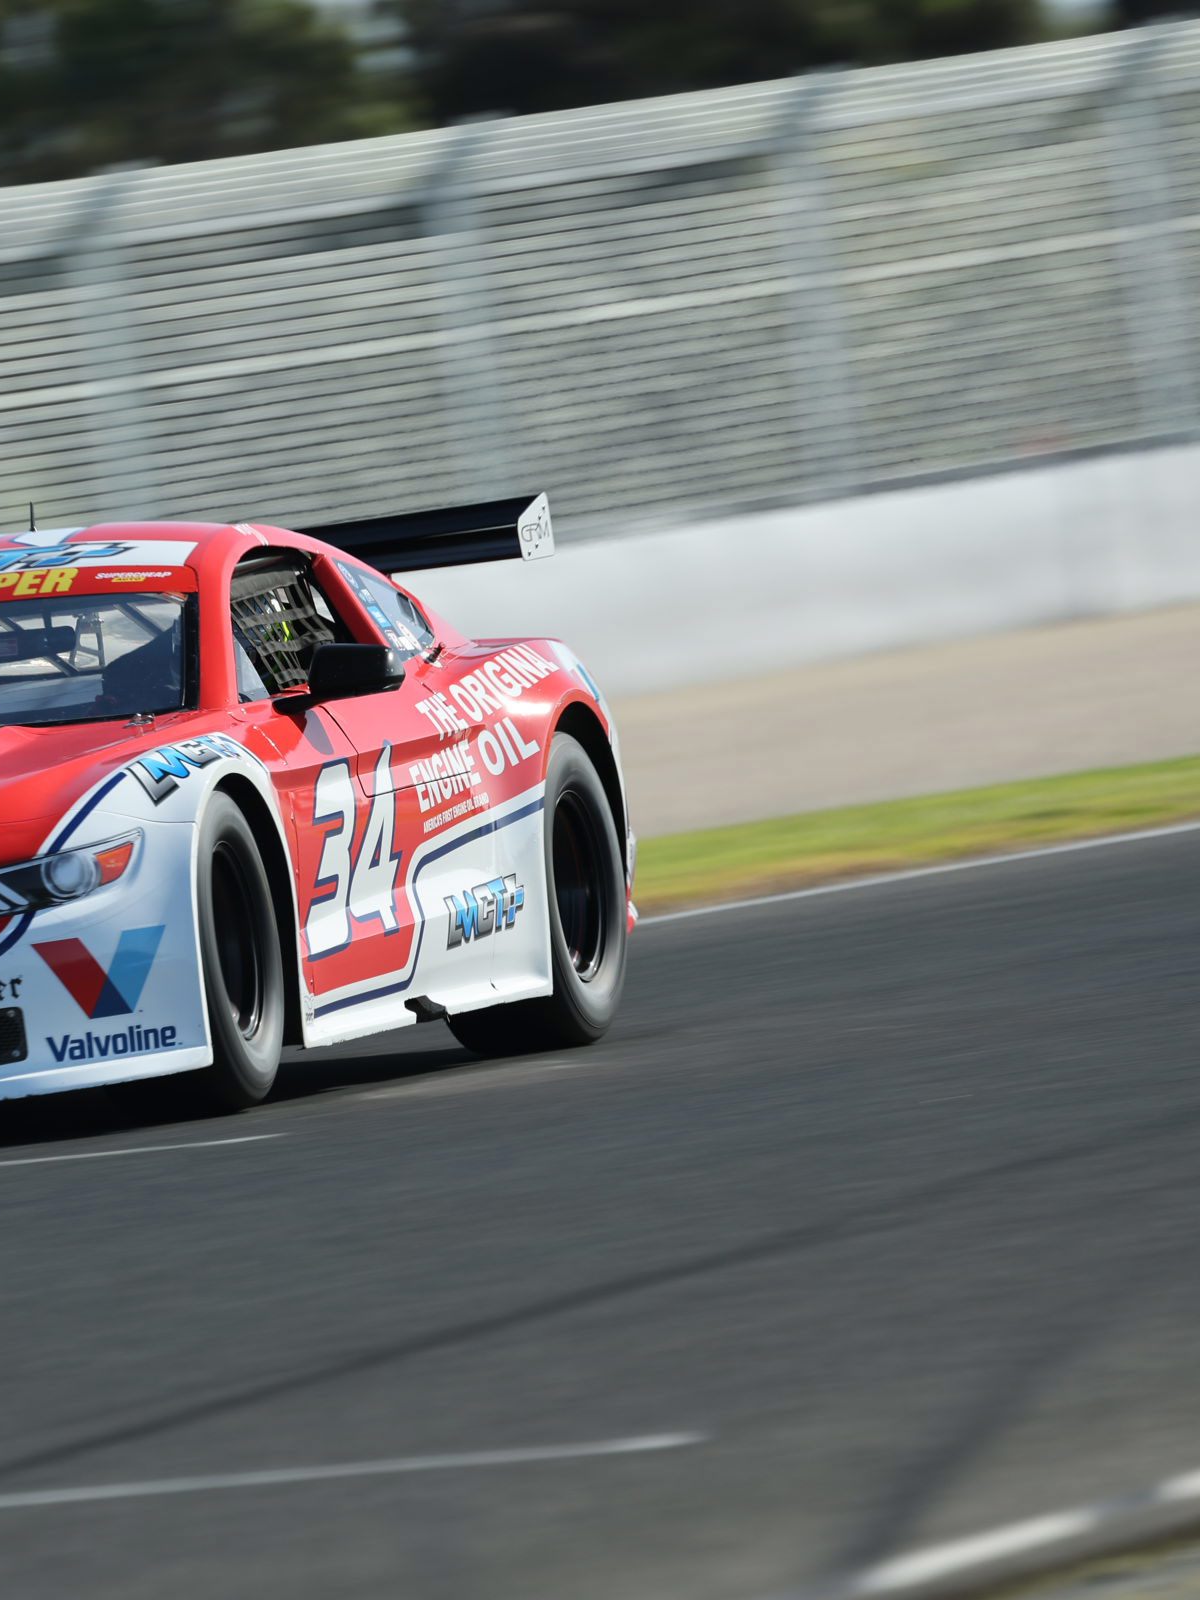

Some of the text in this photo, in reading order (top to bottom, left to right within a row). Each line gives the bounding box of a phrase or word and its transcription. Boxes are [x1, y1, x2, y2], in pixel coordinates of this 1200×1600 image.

[414, 643, 561, 741] THE ORIGINAL
[408, 716, 541, 814] ENGINE OIL
[442, 807, 455, 825] FIRST
[453, 800, 468, 818] ENGINE
[304, 740, 402, 962] 34
[46, 1024, 178, 1063] Valvoline
